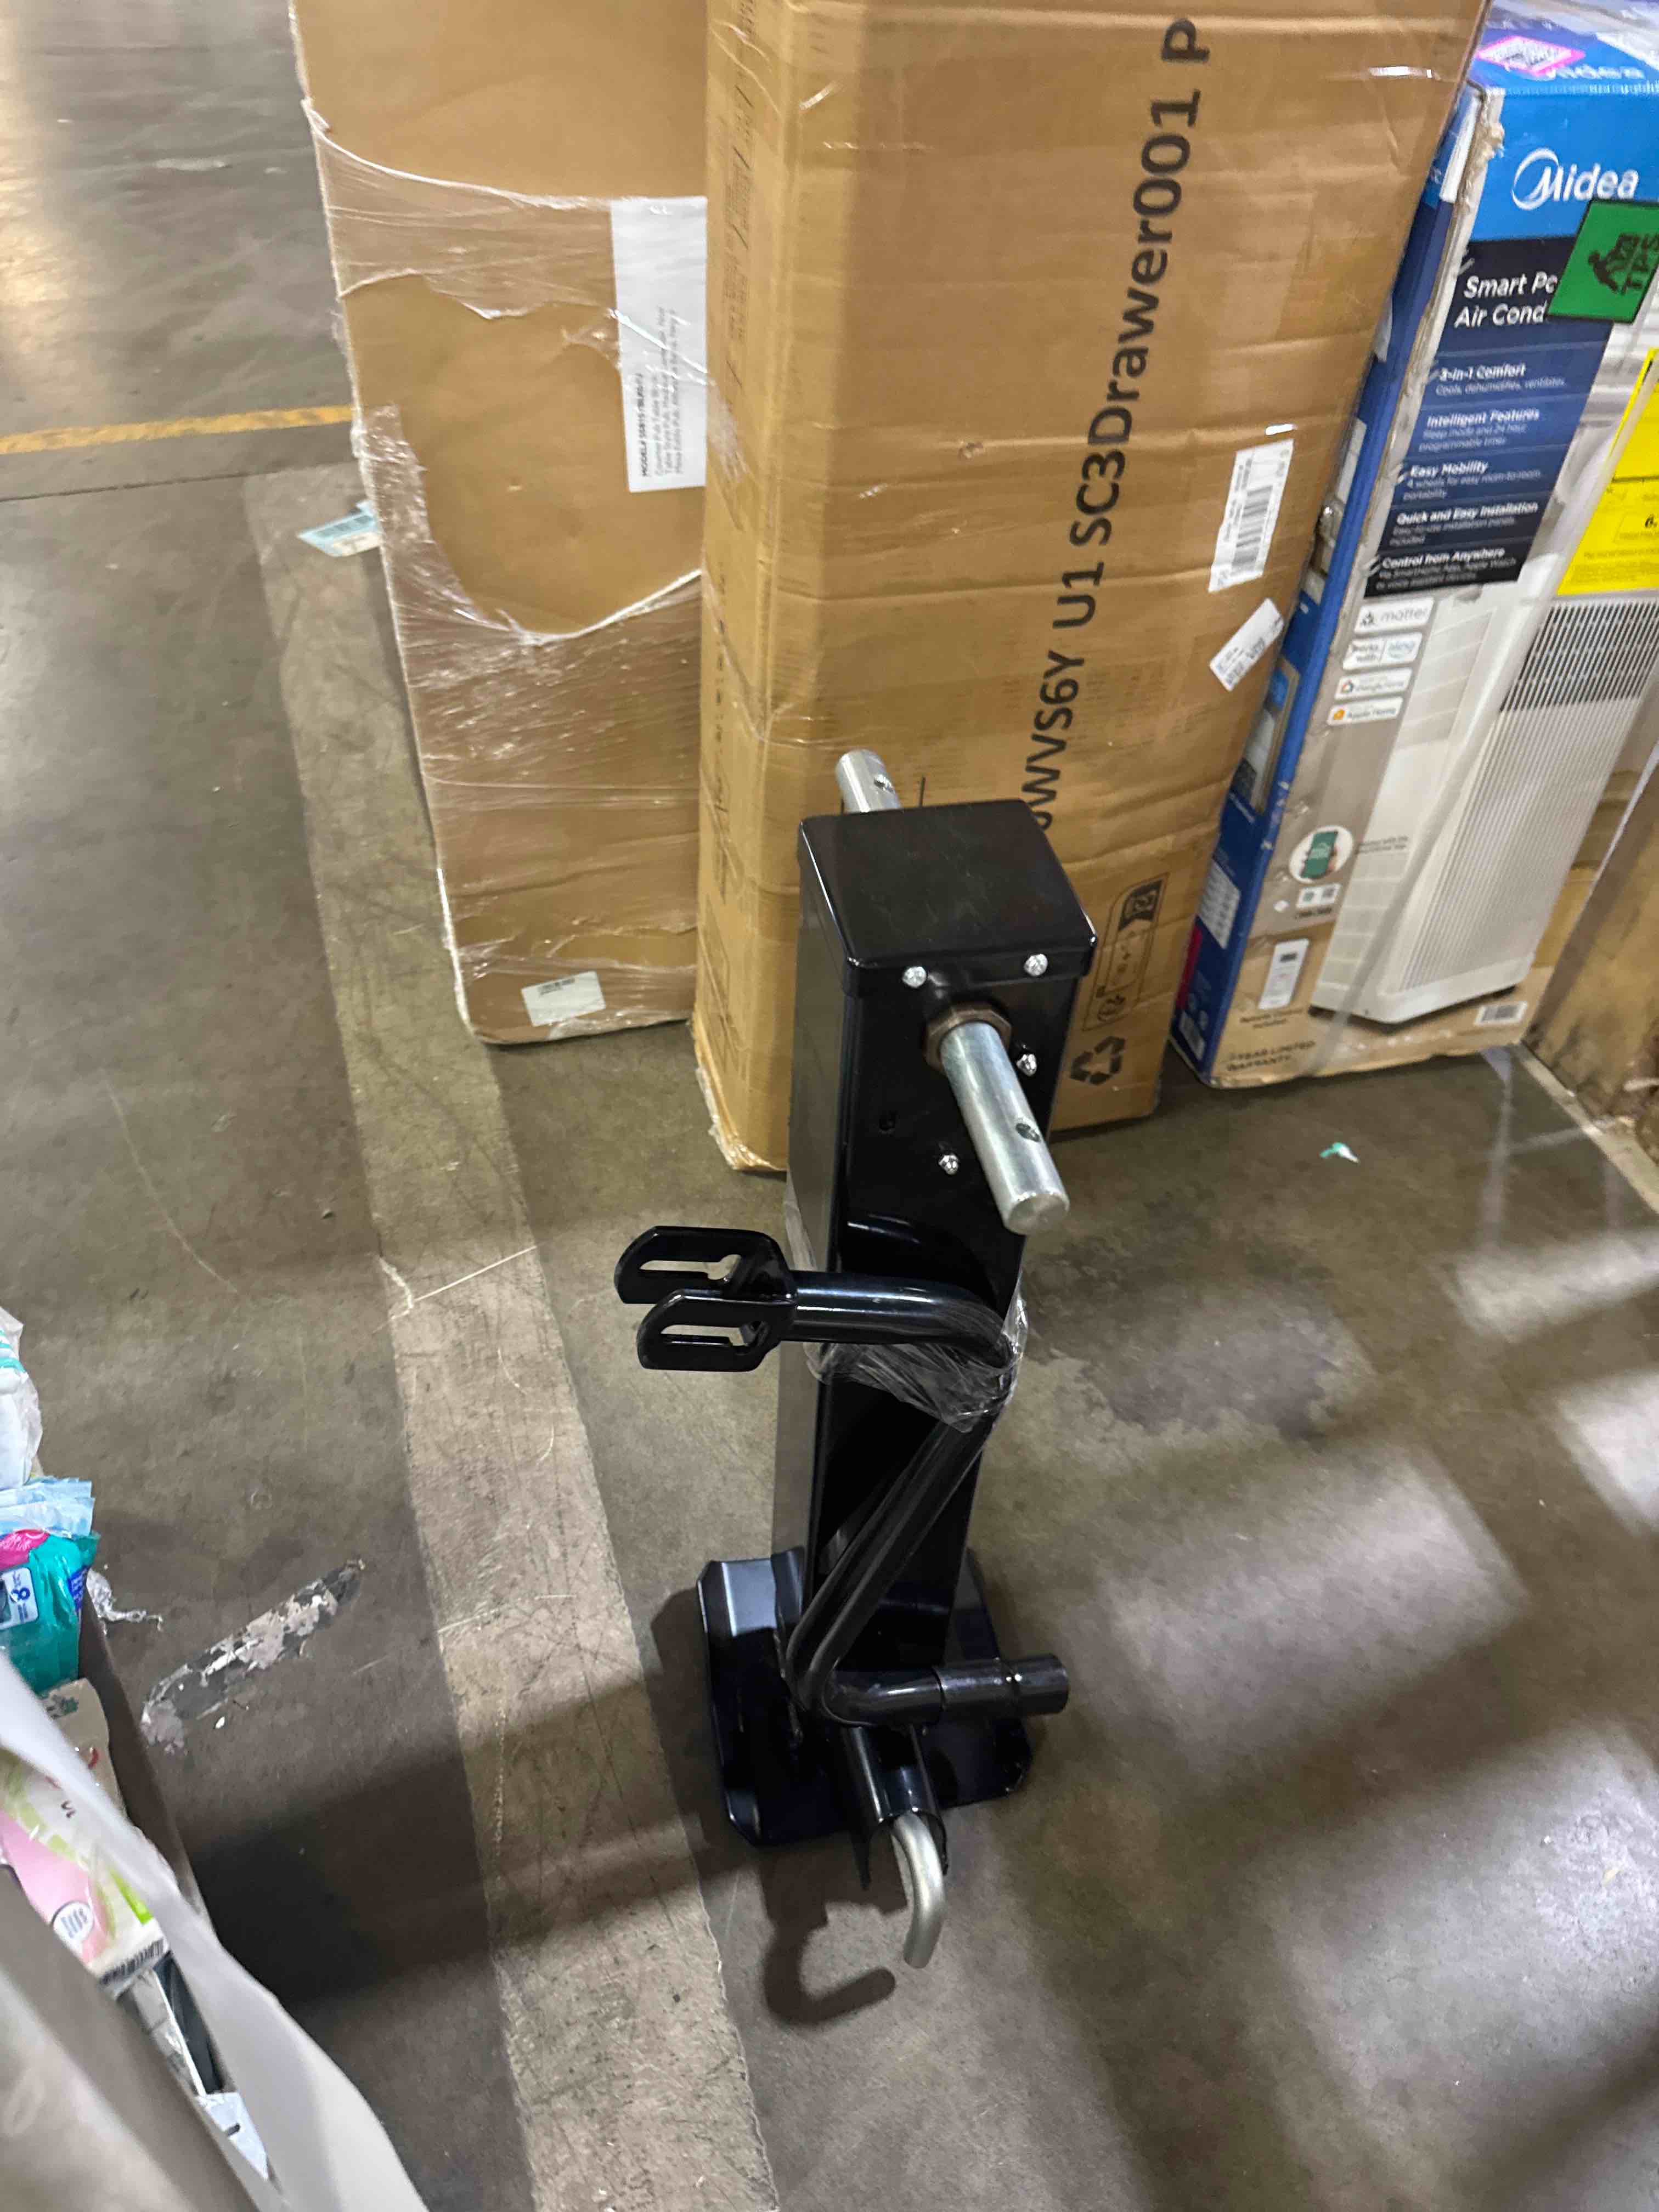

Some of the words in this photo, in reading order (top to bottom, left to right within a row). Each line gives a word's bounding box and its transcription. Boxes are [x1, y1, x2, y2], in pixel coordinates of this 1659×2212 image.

[1160, 18, 1210, 63] P
[1510, 147, 1639, 211] Midea
[1463, 273, 1528, 299] Smart
[1069, 88, 1201, 546] SC3Drawer001
[1454, 305, 1488, 329] Air
[1476, 362, 1527, 379] Comfort
[1426, 413, 1487, 428] Intelligent
[1489, 408, 1540, 422] Features
[1410, 465, 1439, 479] Easy
[1441, 460, 1489, 475] Mobility
[1397, 512, 1428, 526] Quick
[1429, 509, 1452, 522] and
[1452, 507, 1480, 520] Easy
[1480, 501, 1539, 517] Installation
[1382, 556, 1424, 569] Control
[1425, 553, 1450, 565] from
[1451, 548, 1506, 563] Anywhere
[1052, 561, 1104, 629] U1
